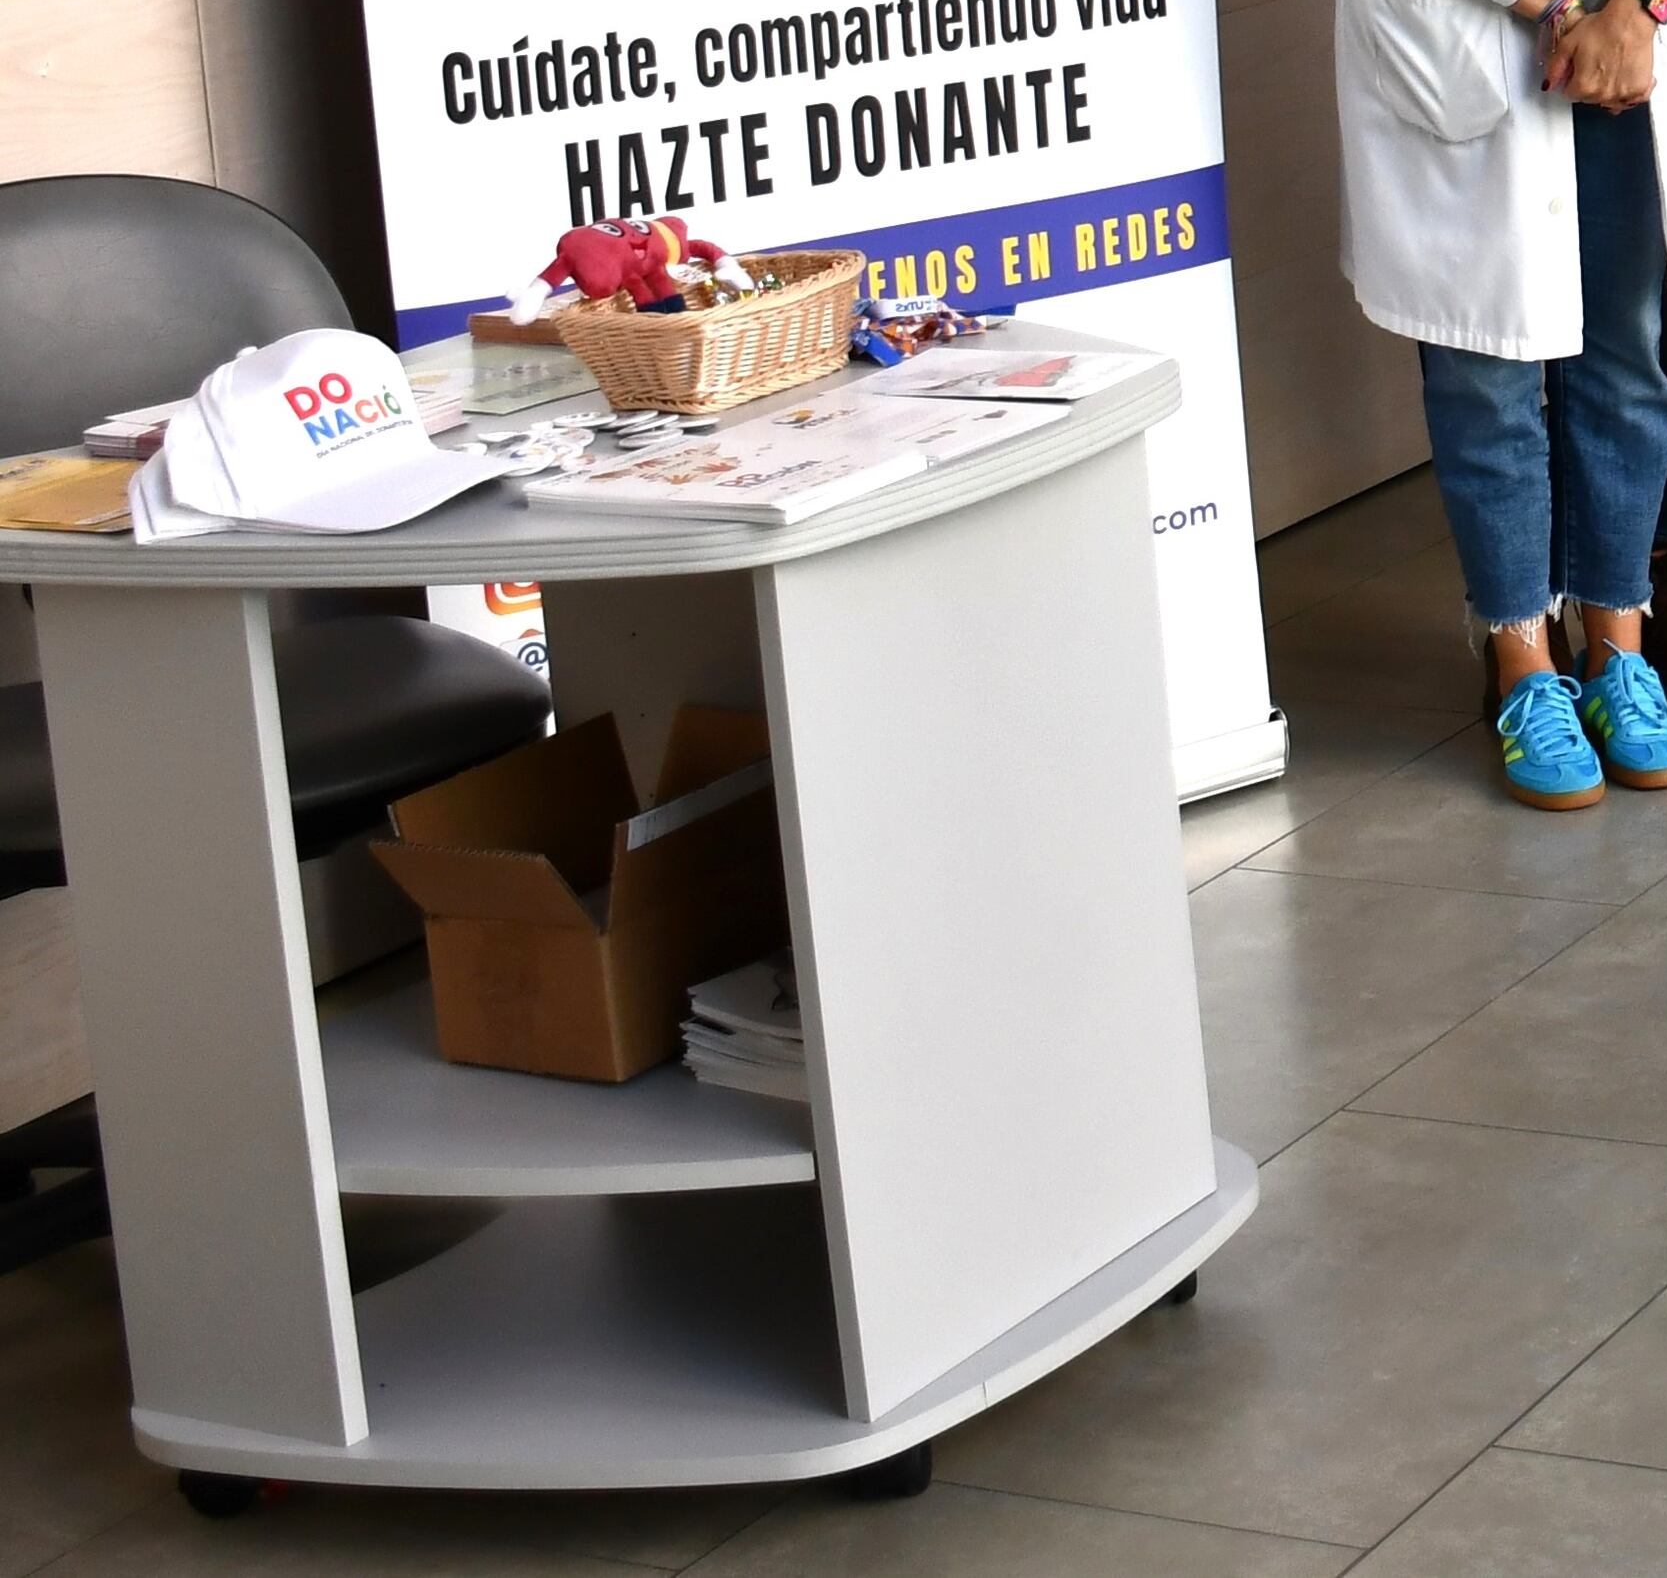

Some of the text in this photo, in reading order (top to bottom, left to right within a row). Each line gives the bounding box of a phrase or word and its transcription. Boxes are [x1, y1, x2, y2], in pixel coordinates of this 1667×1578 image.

[441, 34, 678, 125] Cuídate,
[564, 62, 1092, 228] HAZTE DONANTE
[857, 202, 1197, 300] ENOS EN REDES
[282, 372, 354, 422] DO
[303, 384, 403, 447] NACIÓ
[1152, 502, 1218, 535] com
